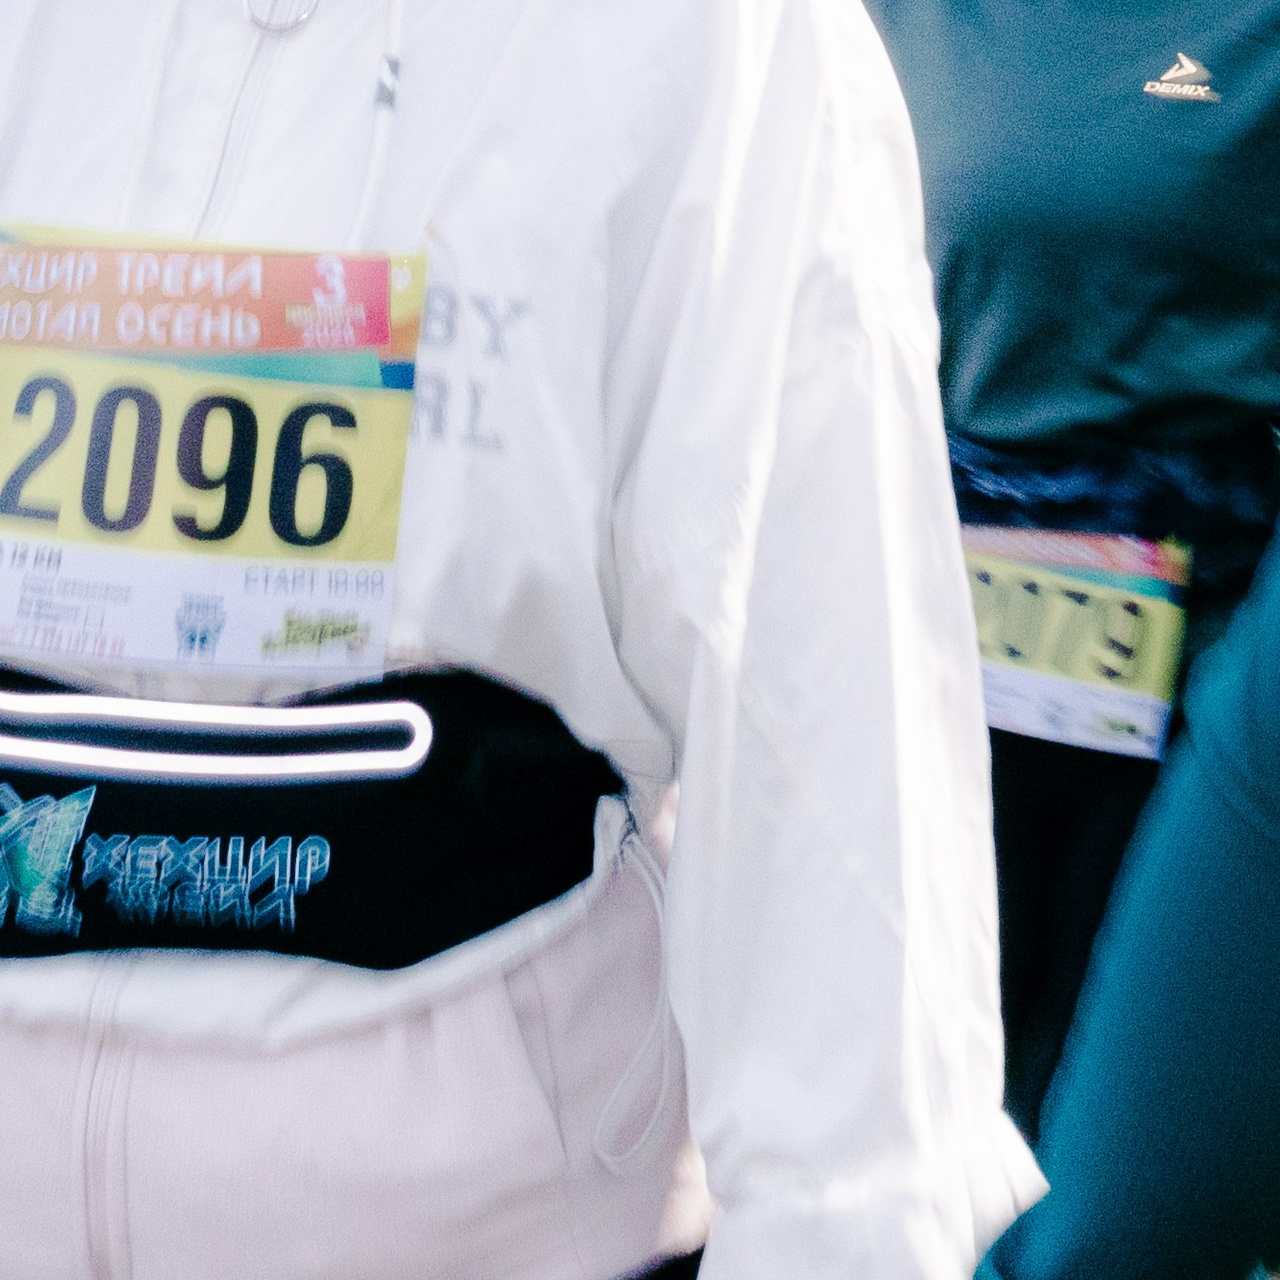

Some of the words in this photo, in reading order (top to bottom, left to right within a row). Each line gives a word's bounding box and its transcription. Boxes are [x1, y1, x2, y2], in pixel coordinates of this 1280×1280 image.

[1143, 81, 1211, 96] DEMIX
[117, 301, 262, 348] ОСЕНЬ
[82, 833, 331, 894] ХЕХЦИР
